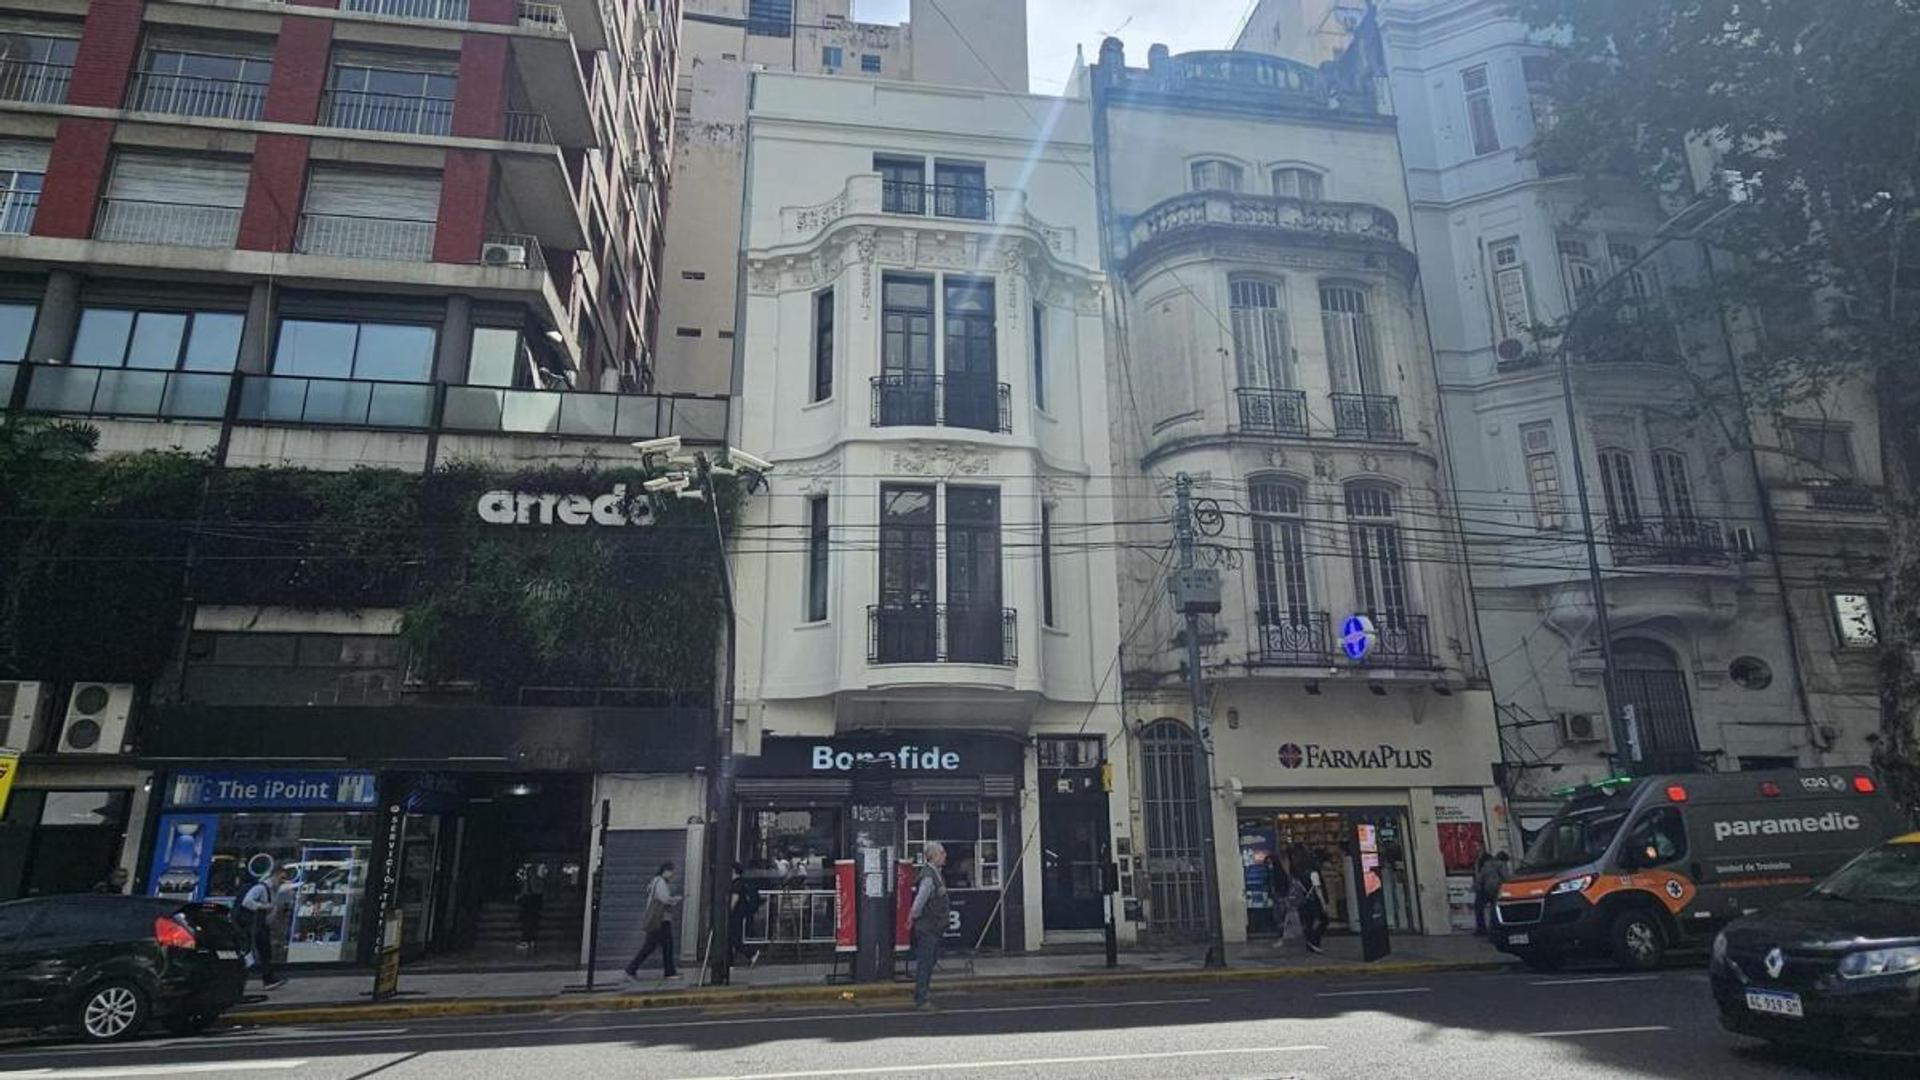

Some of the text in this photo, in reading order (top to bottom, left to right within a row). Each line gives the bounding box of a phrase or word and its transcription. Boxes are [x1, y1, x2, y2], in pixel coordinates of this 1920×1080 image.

[477, 484, 656, 526] arredo
[812, 746, 958, 770] Bonafide
[218, 780, 329, 799] The iPoint
[1713, 813, 1860, 841] paramedic
